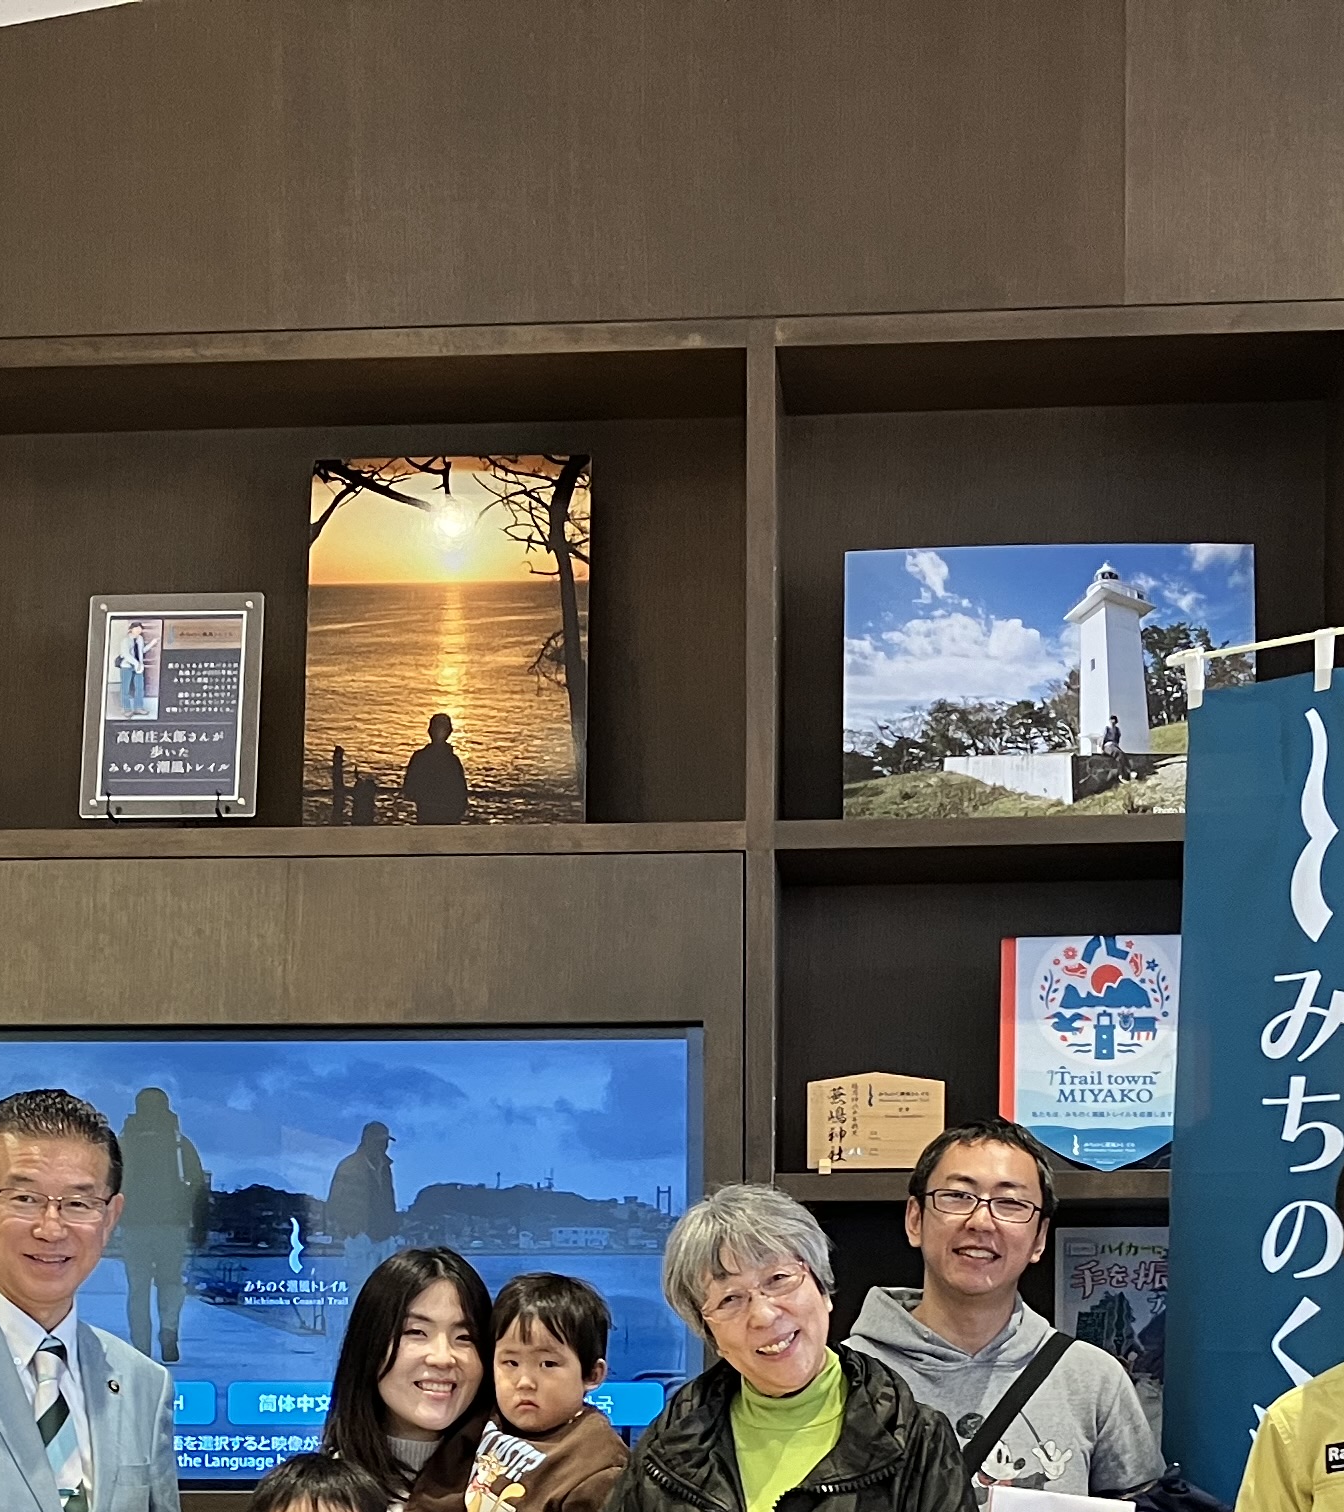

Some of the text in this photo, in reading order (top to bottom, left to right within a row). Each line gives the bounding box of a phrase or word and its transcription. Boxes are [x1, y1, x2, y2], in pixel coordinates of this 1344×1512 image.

[109, 760, 231, 774] みちのく潮風トレイル
[1055, 1070, 1103, 1086] Trail
[1056, 1088, 1154, 1104] MIYAKO
[243, 1280, 349, 1293] みちのく潮風トレイル
[258, 1394, 332, 1413] 简体中文
[174, 1435, 322, 1452] 語を選択すると映像が
[177, 1453, 202, 1468] the
[205, 1454, 274, 1471] Language
